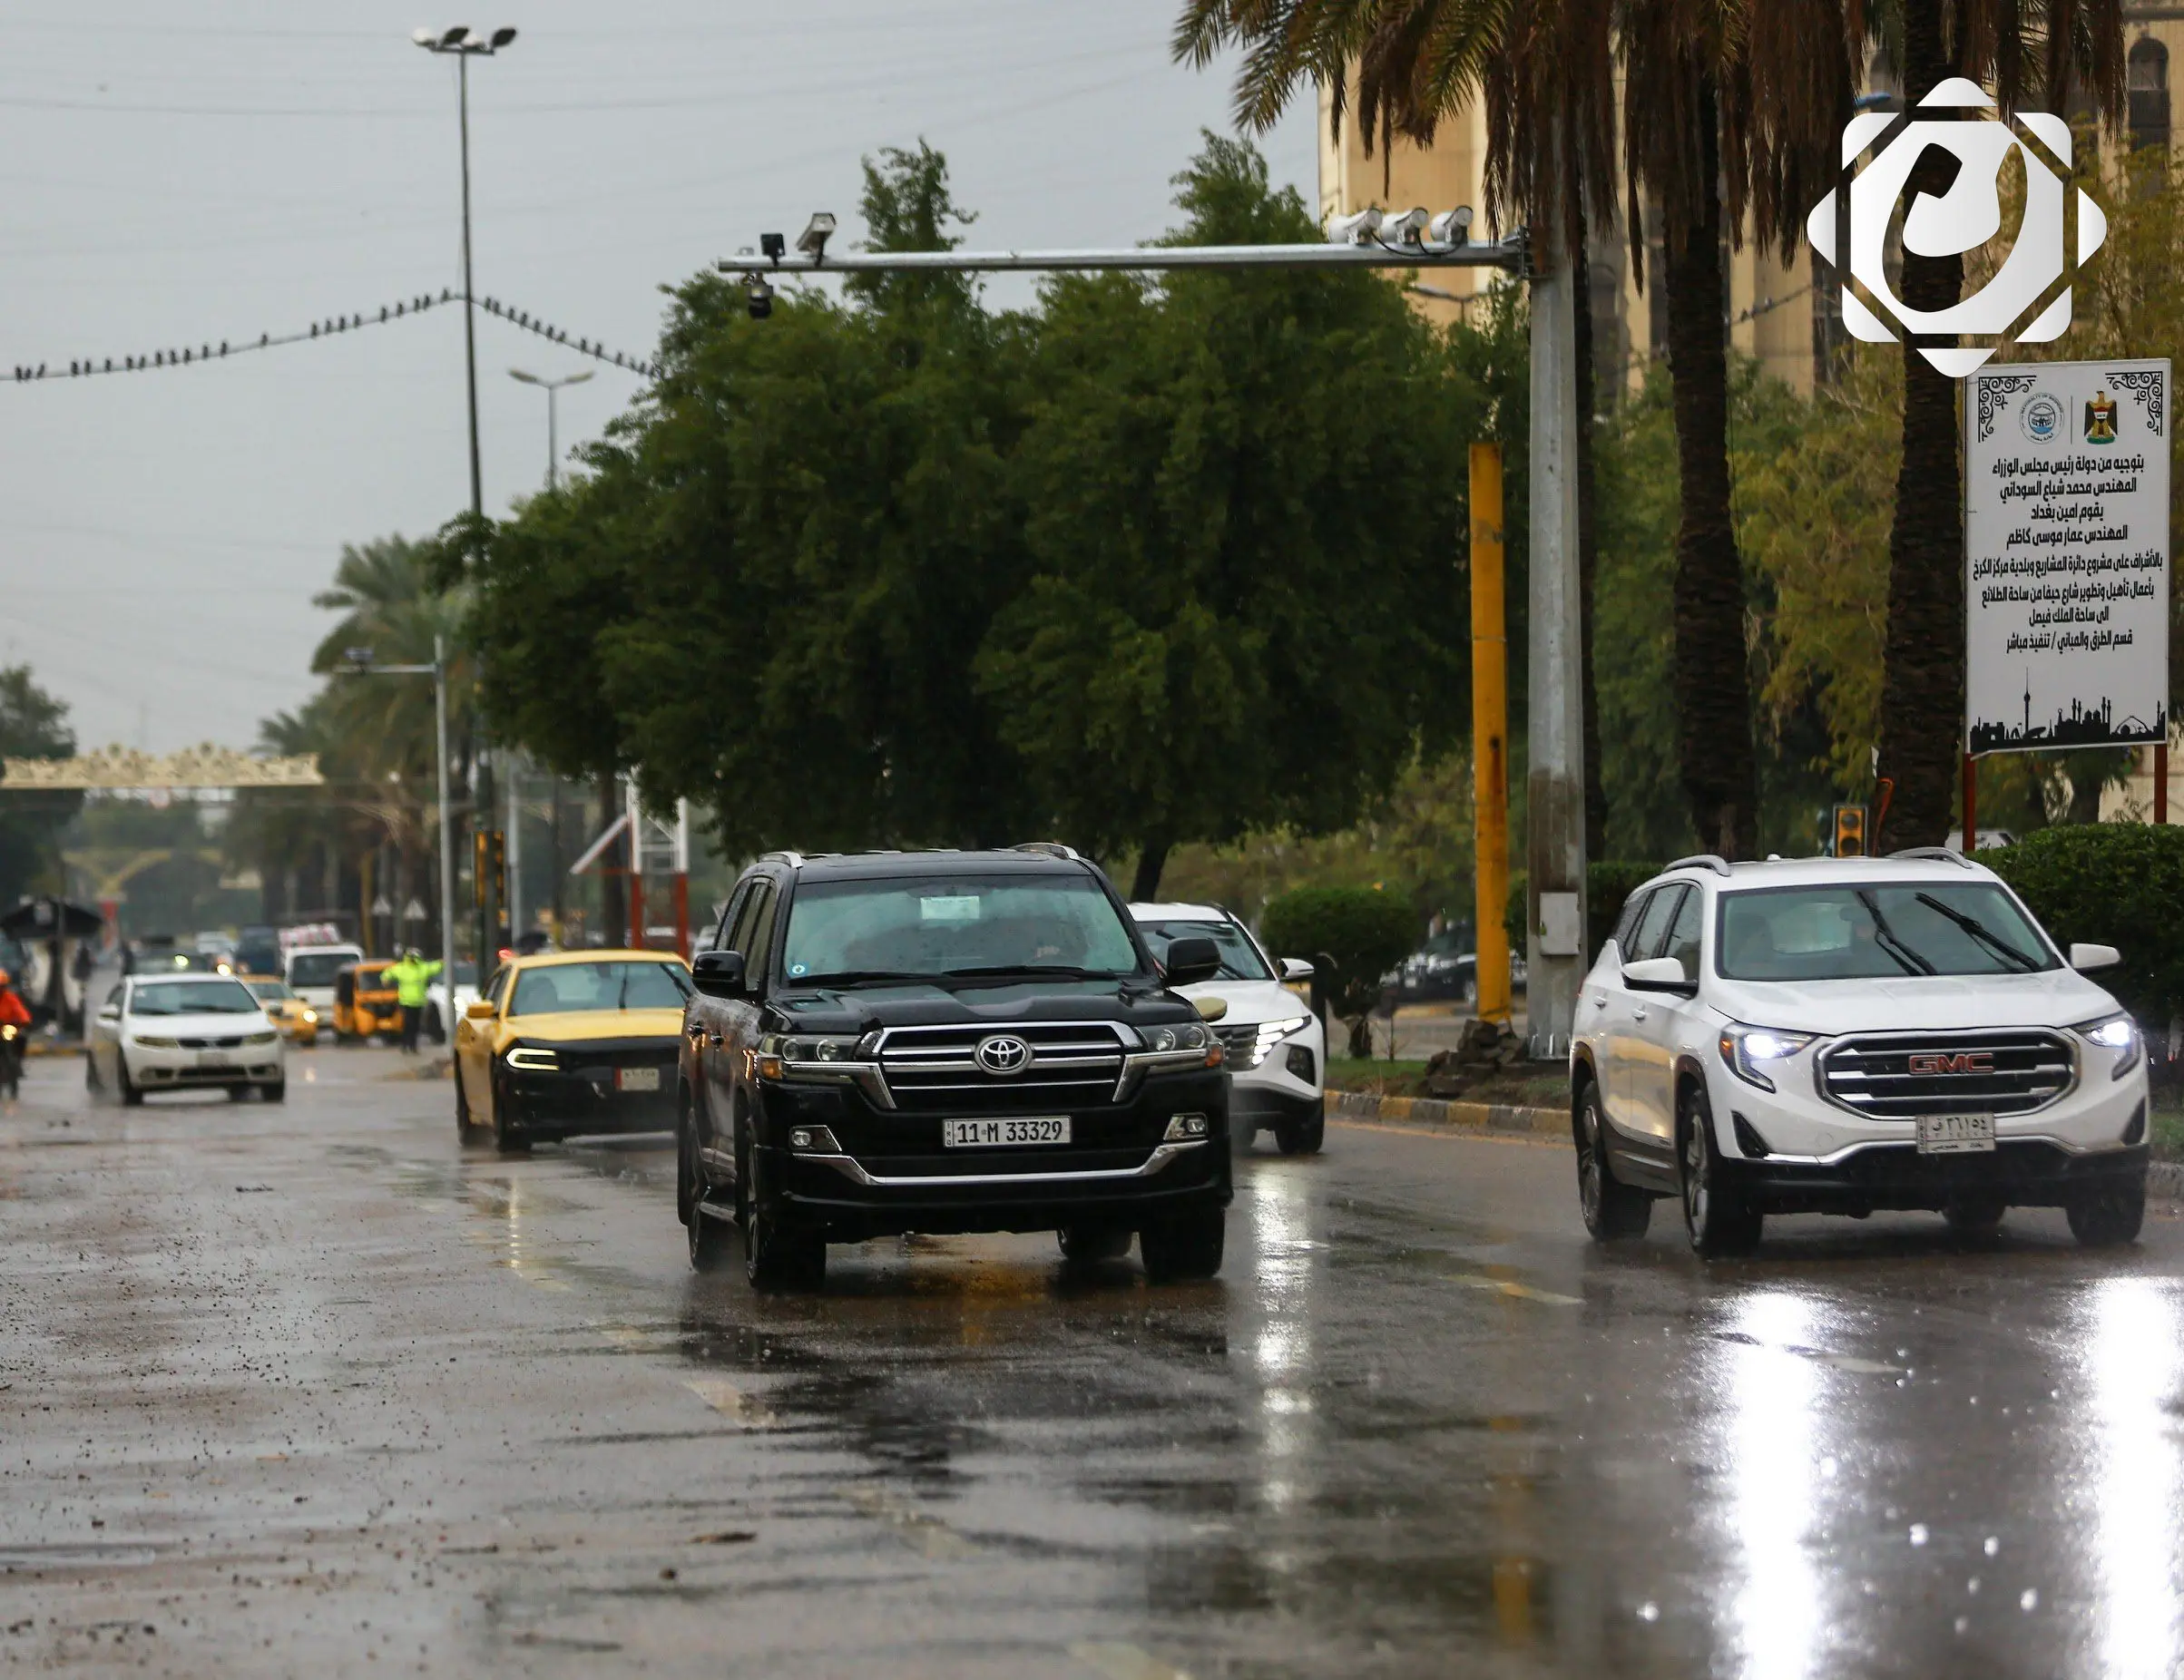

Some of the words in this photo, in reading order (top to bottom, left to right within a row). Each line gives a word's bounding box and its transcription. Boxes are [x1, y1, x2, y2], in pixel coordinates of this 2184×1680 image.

[1993, 458, 2019, 478] الوزراء
[2020, 457, 2049, 476] مجلس
[2051, 455, 2073, 475] رئيس
[2076, 455, 2096, 474] دولة
[2098, 457, 2111, 473] من
[2113, 454, 2144, 474] بتوجيه
[2000, 481, 2042, 503] السوداني
[2043, 478, 2064, 502] شياع
[2066, 483, 2091, 494] محمد
[2093, 477, 2136, 496] المهندس
[2031, 503, 2055, 523] بغداد
[2079, 502, 2103, 523] يقوم
[2006, 527, 2031, 551] كاظم
[2032, 532, 2062, 547] موسى
[2064, 526, 2082, 546] عمار
[2084, 524, 2128, 544] المهندس
[1973, 557, 1992, 581] الكرخ
[1993, 557, 2008, 578] مركز
[2068, 554, 2085, 575] دائرة
[2087, 552, 2112, 577] مشروع
[2113, 553, 2130, 571] على
[1982, 586, 2007, 609] الطلائع
[2009, 585, 2029, 601] ساحة
[2030, 588, 2042, 603] من
[2062, 581, 2079, 606] شارع
[2080, 582, 2105, 602] وتطوير
[2029, 608, 2051, 628] فيصل
[2052, 607, 2073, 623] الملك
[2075, 607, 2095, 622] ساحة
[2007, 632, 2028, 653] مباشر
[2029, 633, 2050, 652] تنفيذ
[2091, 630, 2111, 651] الطرق
[2112, 630, 2132, 650] قسم
[1909, 1052, 1994, 1074] GMC
[957, 1122, 980, 1143] 11
[1005, 1120, 1063, 1141] 33329
